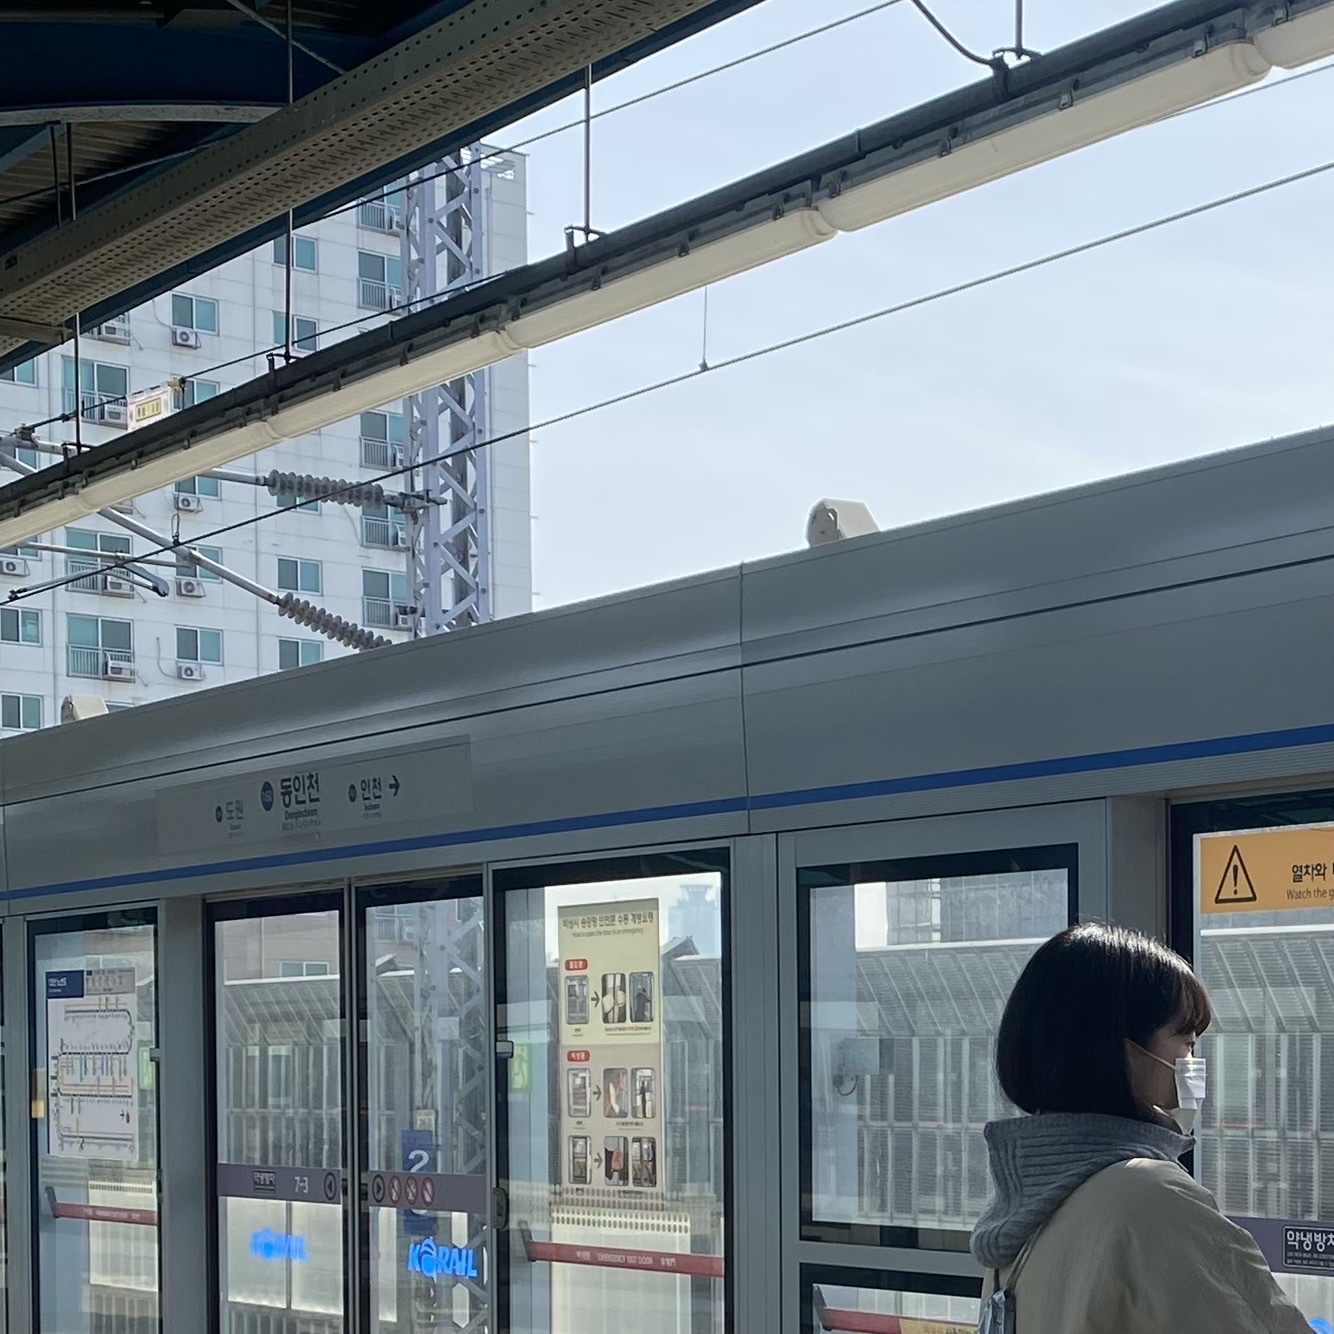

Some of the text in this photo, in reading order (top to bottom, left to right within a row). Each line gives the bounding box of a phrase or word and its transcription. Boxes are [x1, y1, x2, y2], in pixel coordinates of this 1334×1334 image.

[280, 772, 320, 808] 동인천
[361, 777, 382, 801] 인천
[226, 799, 244, 820] 도원
[1291, 863, 1327, 883] 열차와
[1286, 888, 1312, 901] Watch
[1313, 887, 1327, 899] the
[294, 1176, 309, 1193] 7-3
[407, 1237, 478, 1278] KORAIL
